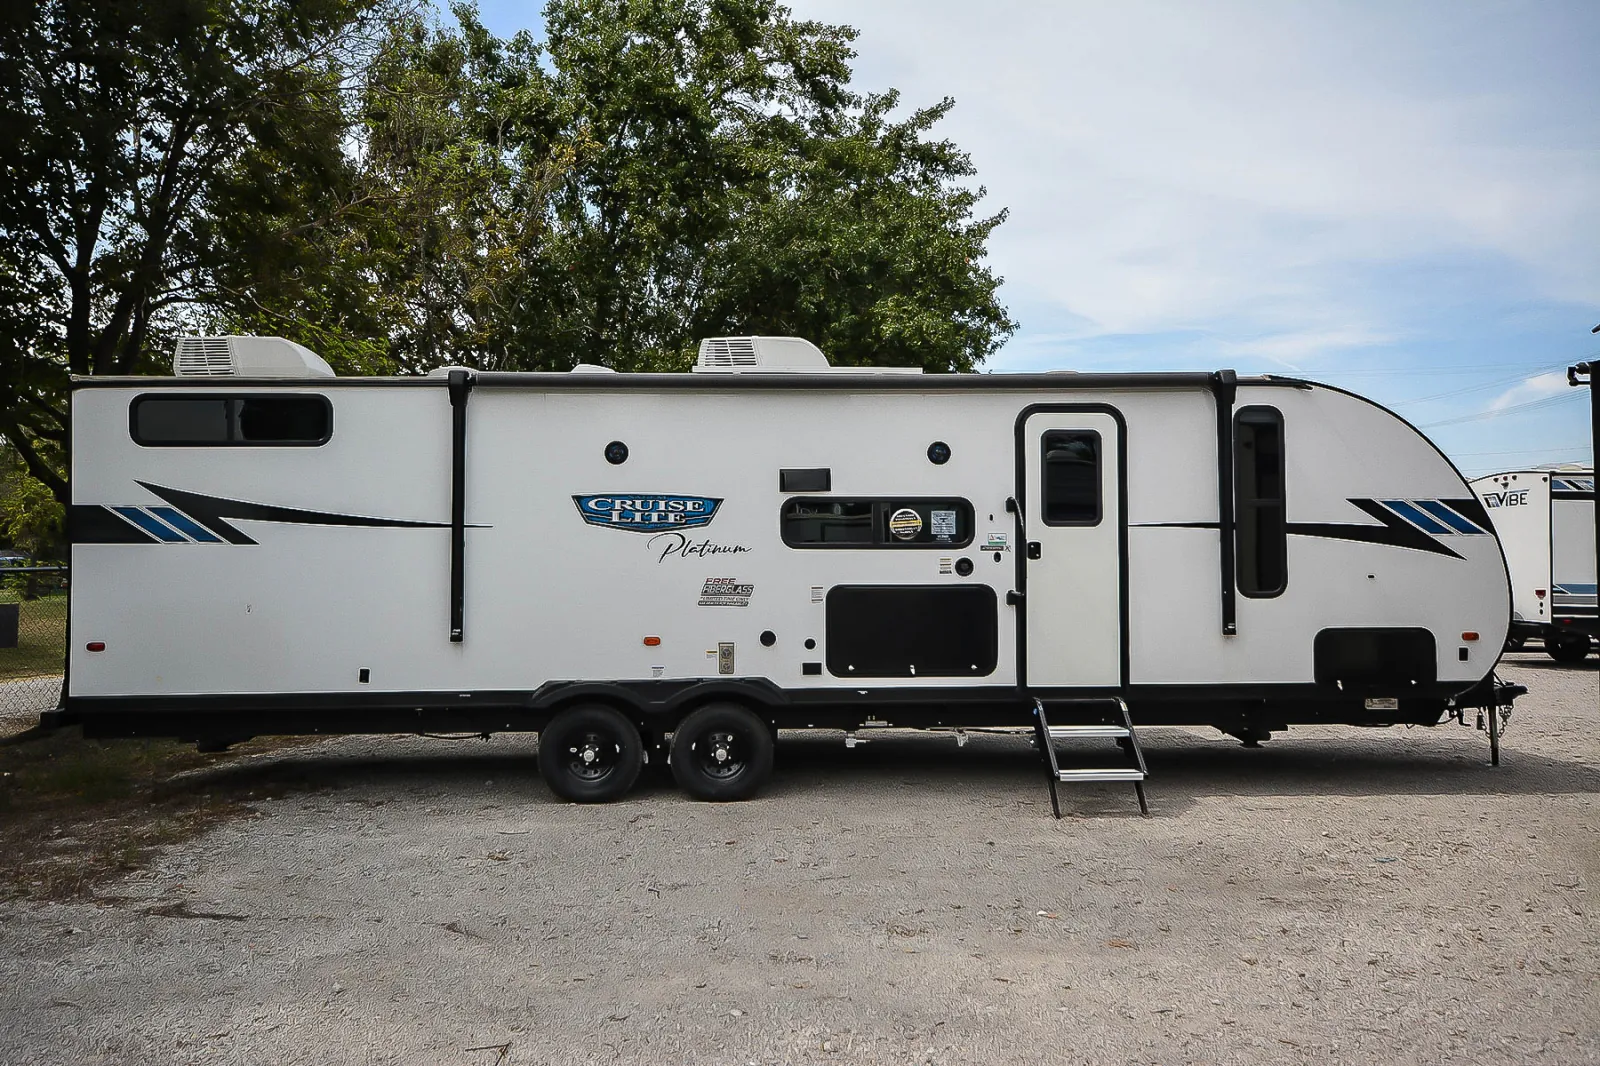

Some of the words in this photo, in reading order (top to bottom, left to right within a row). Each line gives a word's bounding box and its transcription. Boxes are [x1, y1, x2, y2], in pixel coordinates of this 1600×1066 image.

[587, 498, 704, 512] CRUISE
[1493, 490, 1529, 507] VIBE
[610, 510, 686, 524] LITE
[647, 532, 752, 563] Platinum
[702, 584, 753, 594] FIBERGLASS
